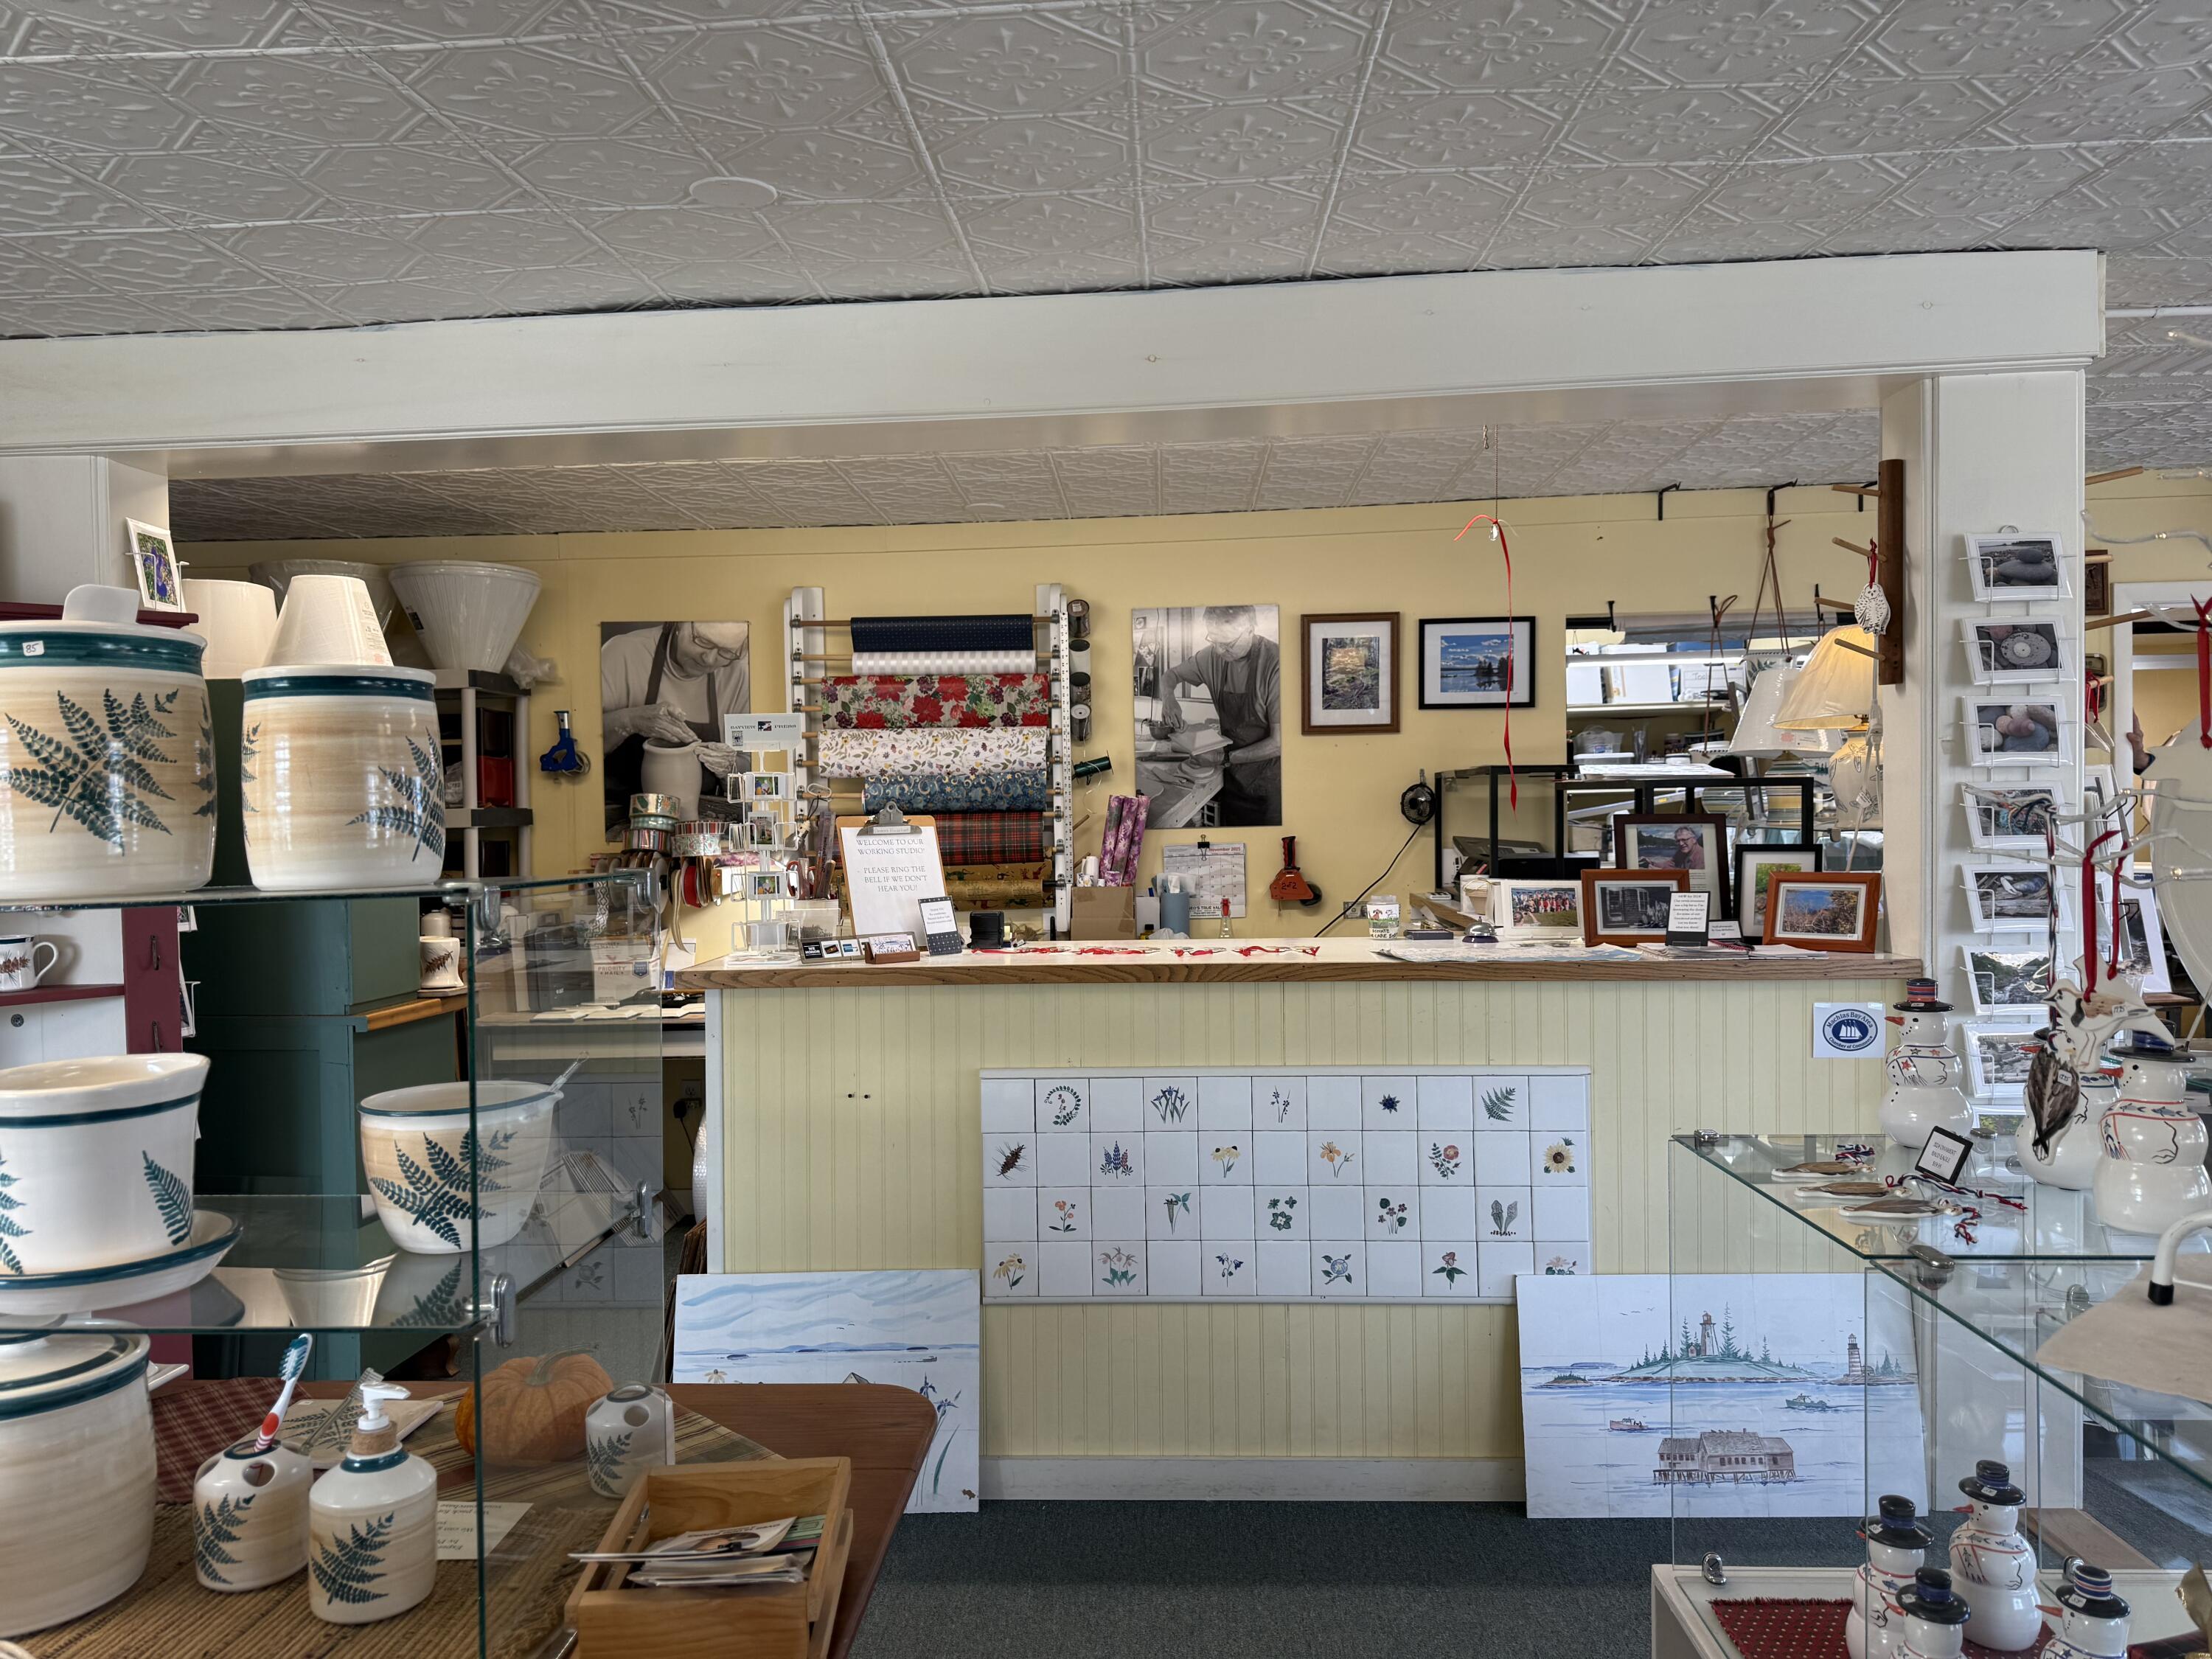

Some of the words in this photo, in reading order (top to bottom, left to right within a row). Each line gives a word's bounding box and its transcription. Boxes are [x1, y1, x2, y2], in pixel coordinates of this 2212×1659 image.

[1826, 1013, 1850, 1029] Machias
[1861, 1016, 1874, 1028] Area
[1829, 1037, 1847, 1048] Chamber
[1852, 1035, 1874, 1048] Commerce
